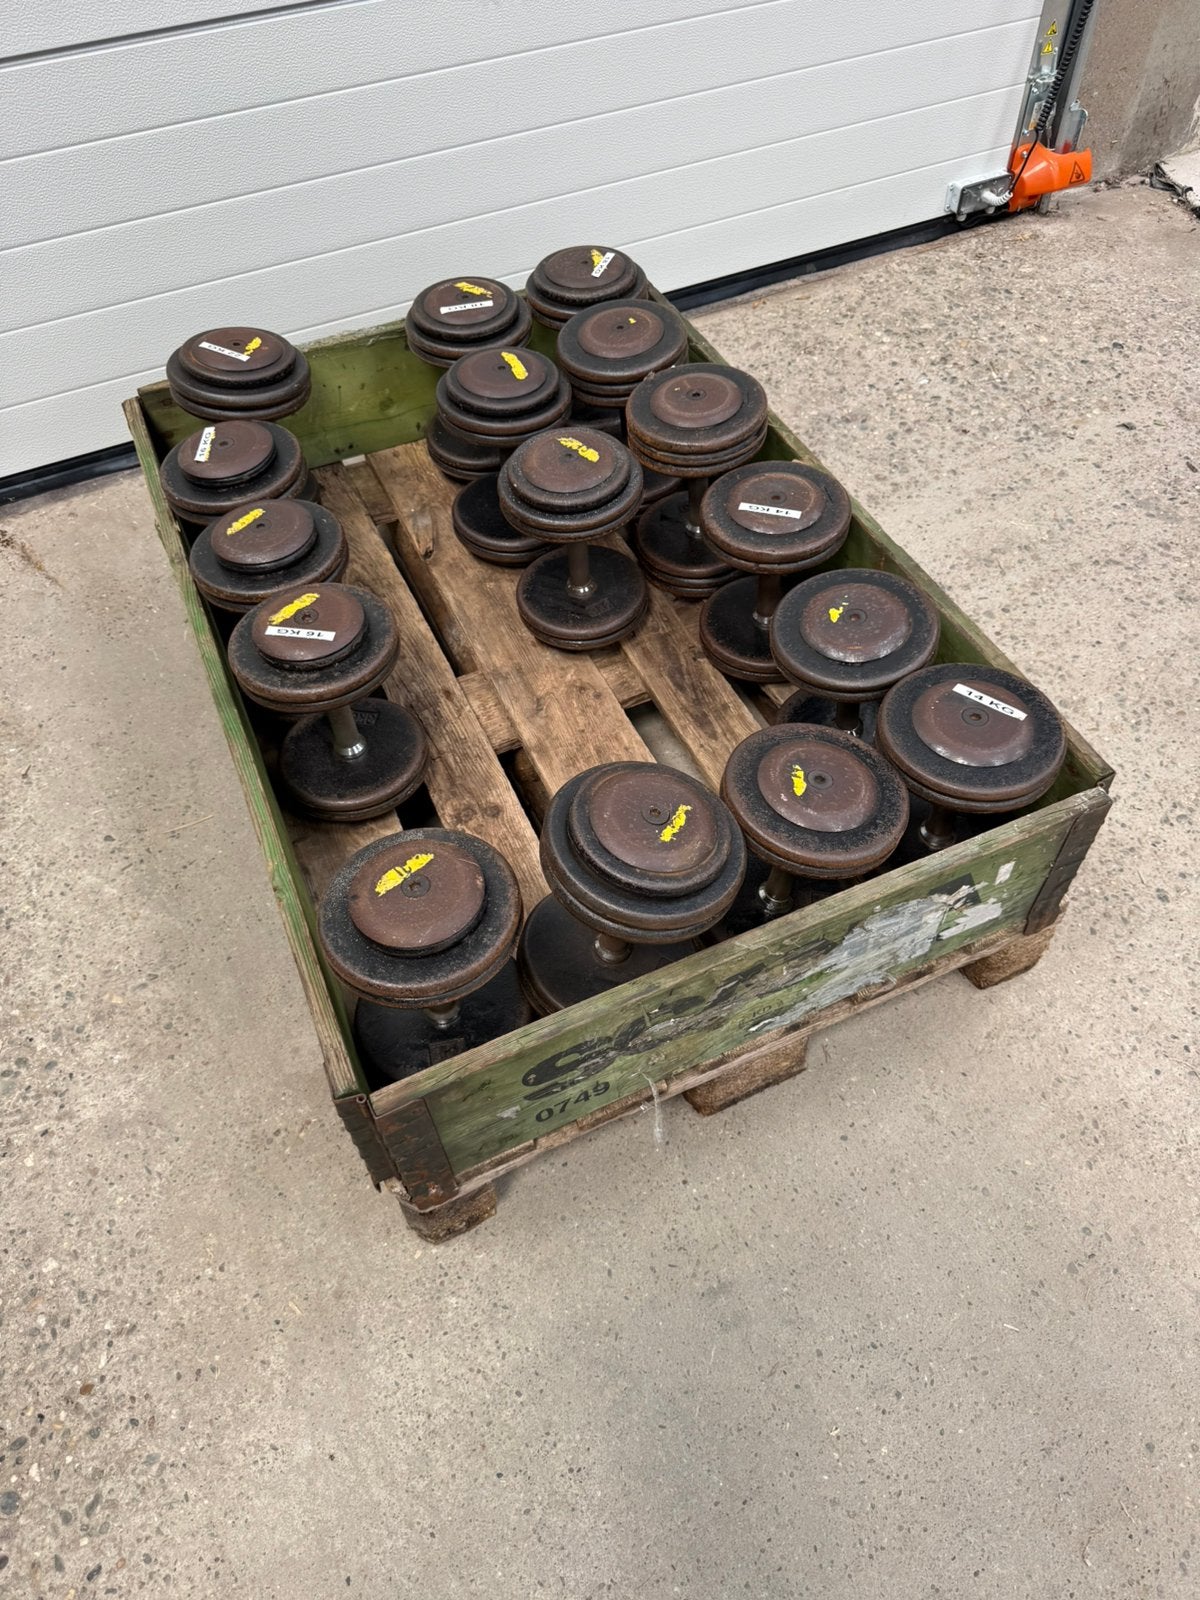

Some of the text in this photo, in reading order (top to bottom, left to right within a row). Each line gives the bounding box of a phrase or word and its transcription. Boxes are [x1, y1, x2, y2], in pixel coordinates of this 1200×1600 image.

[277, 628, 301, 636] KG
[966, 689, 1015, 715] 14 KG
[535, 1081, 611, 1122] 0749
